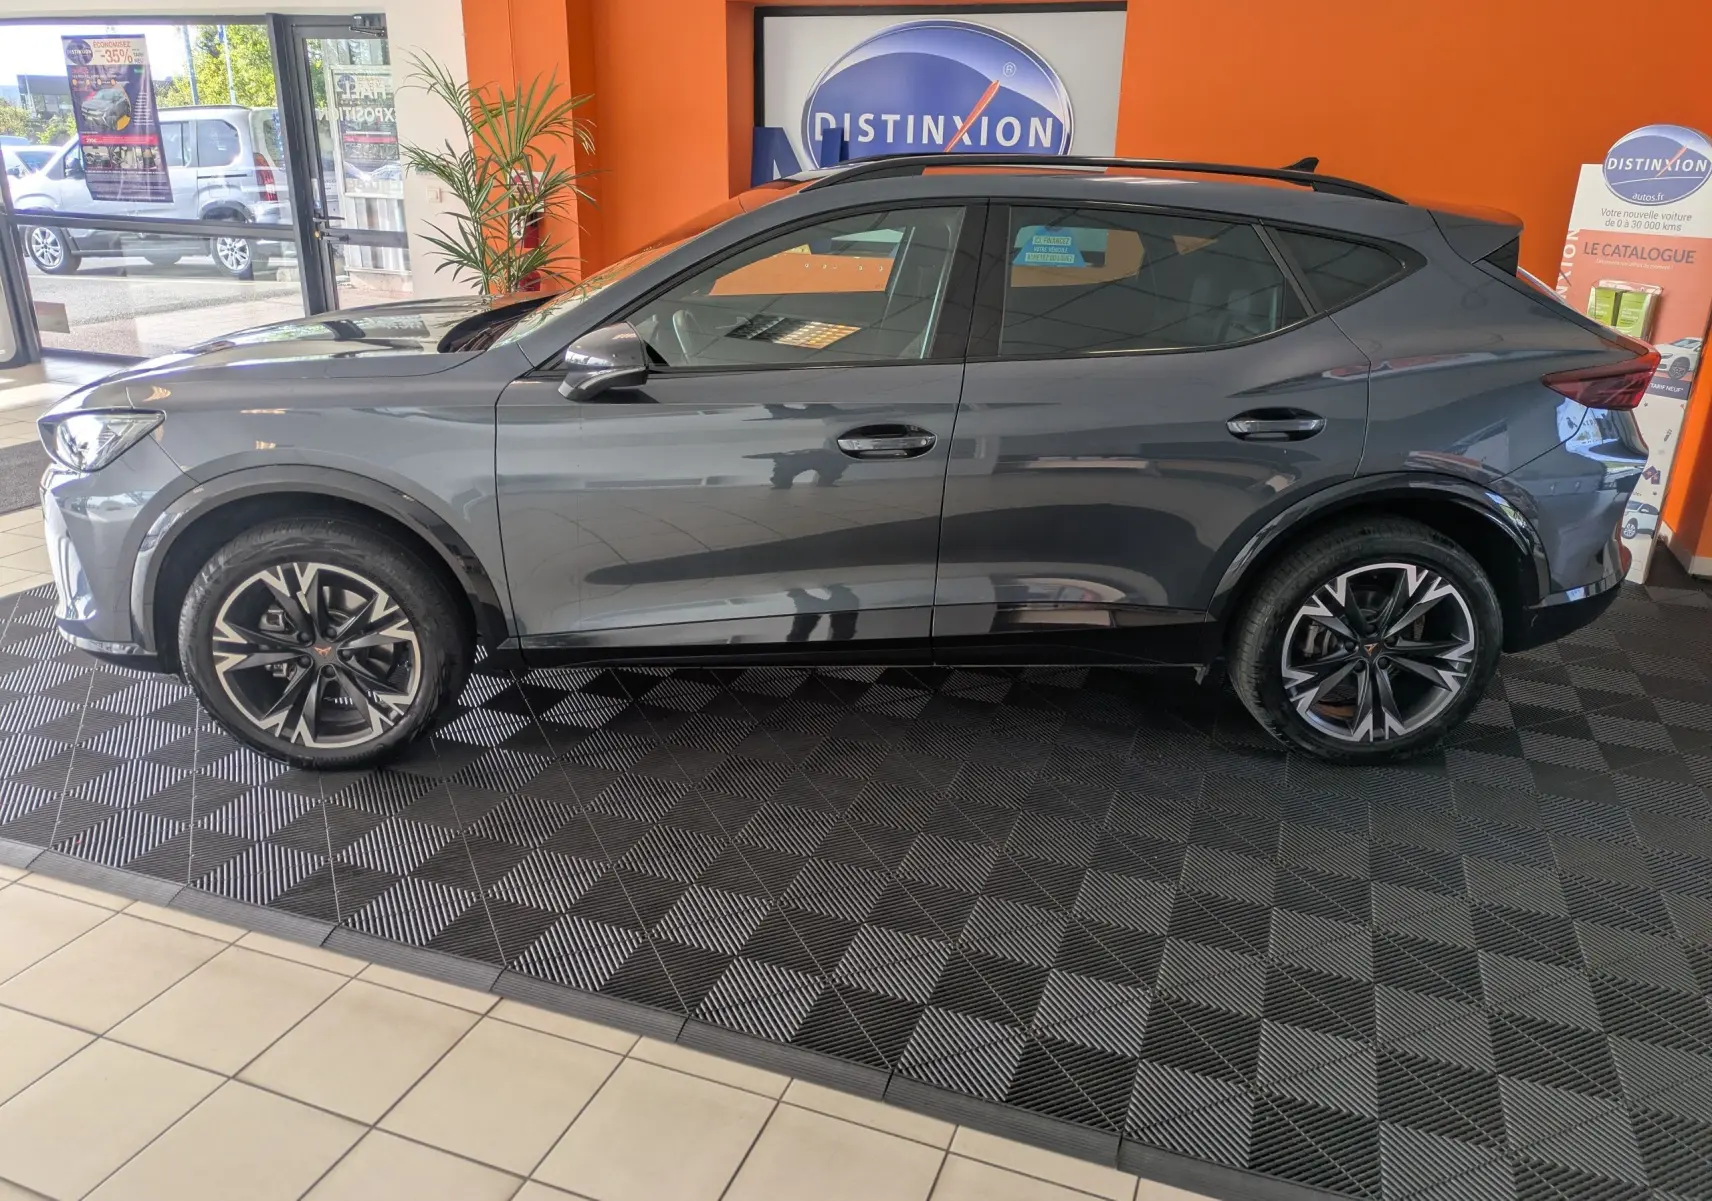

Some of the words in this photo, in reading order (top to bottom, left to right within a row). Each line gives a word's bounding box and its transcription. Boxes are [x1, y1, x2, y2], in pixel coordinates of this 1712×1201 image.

[93, 40, 131, 48] ÉCONOMISEZ
[814, 112, 1053, 148] DISTINXION
[1607, 158, 1708, 172] DISTINXION
[1632, 192, 1665, 202] autos.fr
[1601, 208, 1622, 218] Votre
[1623, 210, 1659, 220] nouvelle
[1661, 212, 1693, 222] voiture
[1605, 218, 1615, 228] de
[1616, 220, 1623, 228] 0
[1624, 219, 1630, 228] à
[1631, 220, 1643, 229] 30
[1644, 221, 1661, 230] 000
[1662, 222, 1683, 232] kms
[1583, 241, 1600, 256] LE
[1601, 243, 1697, 264] CATALOGUE
